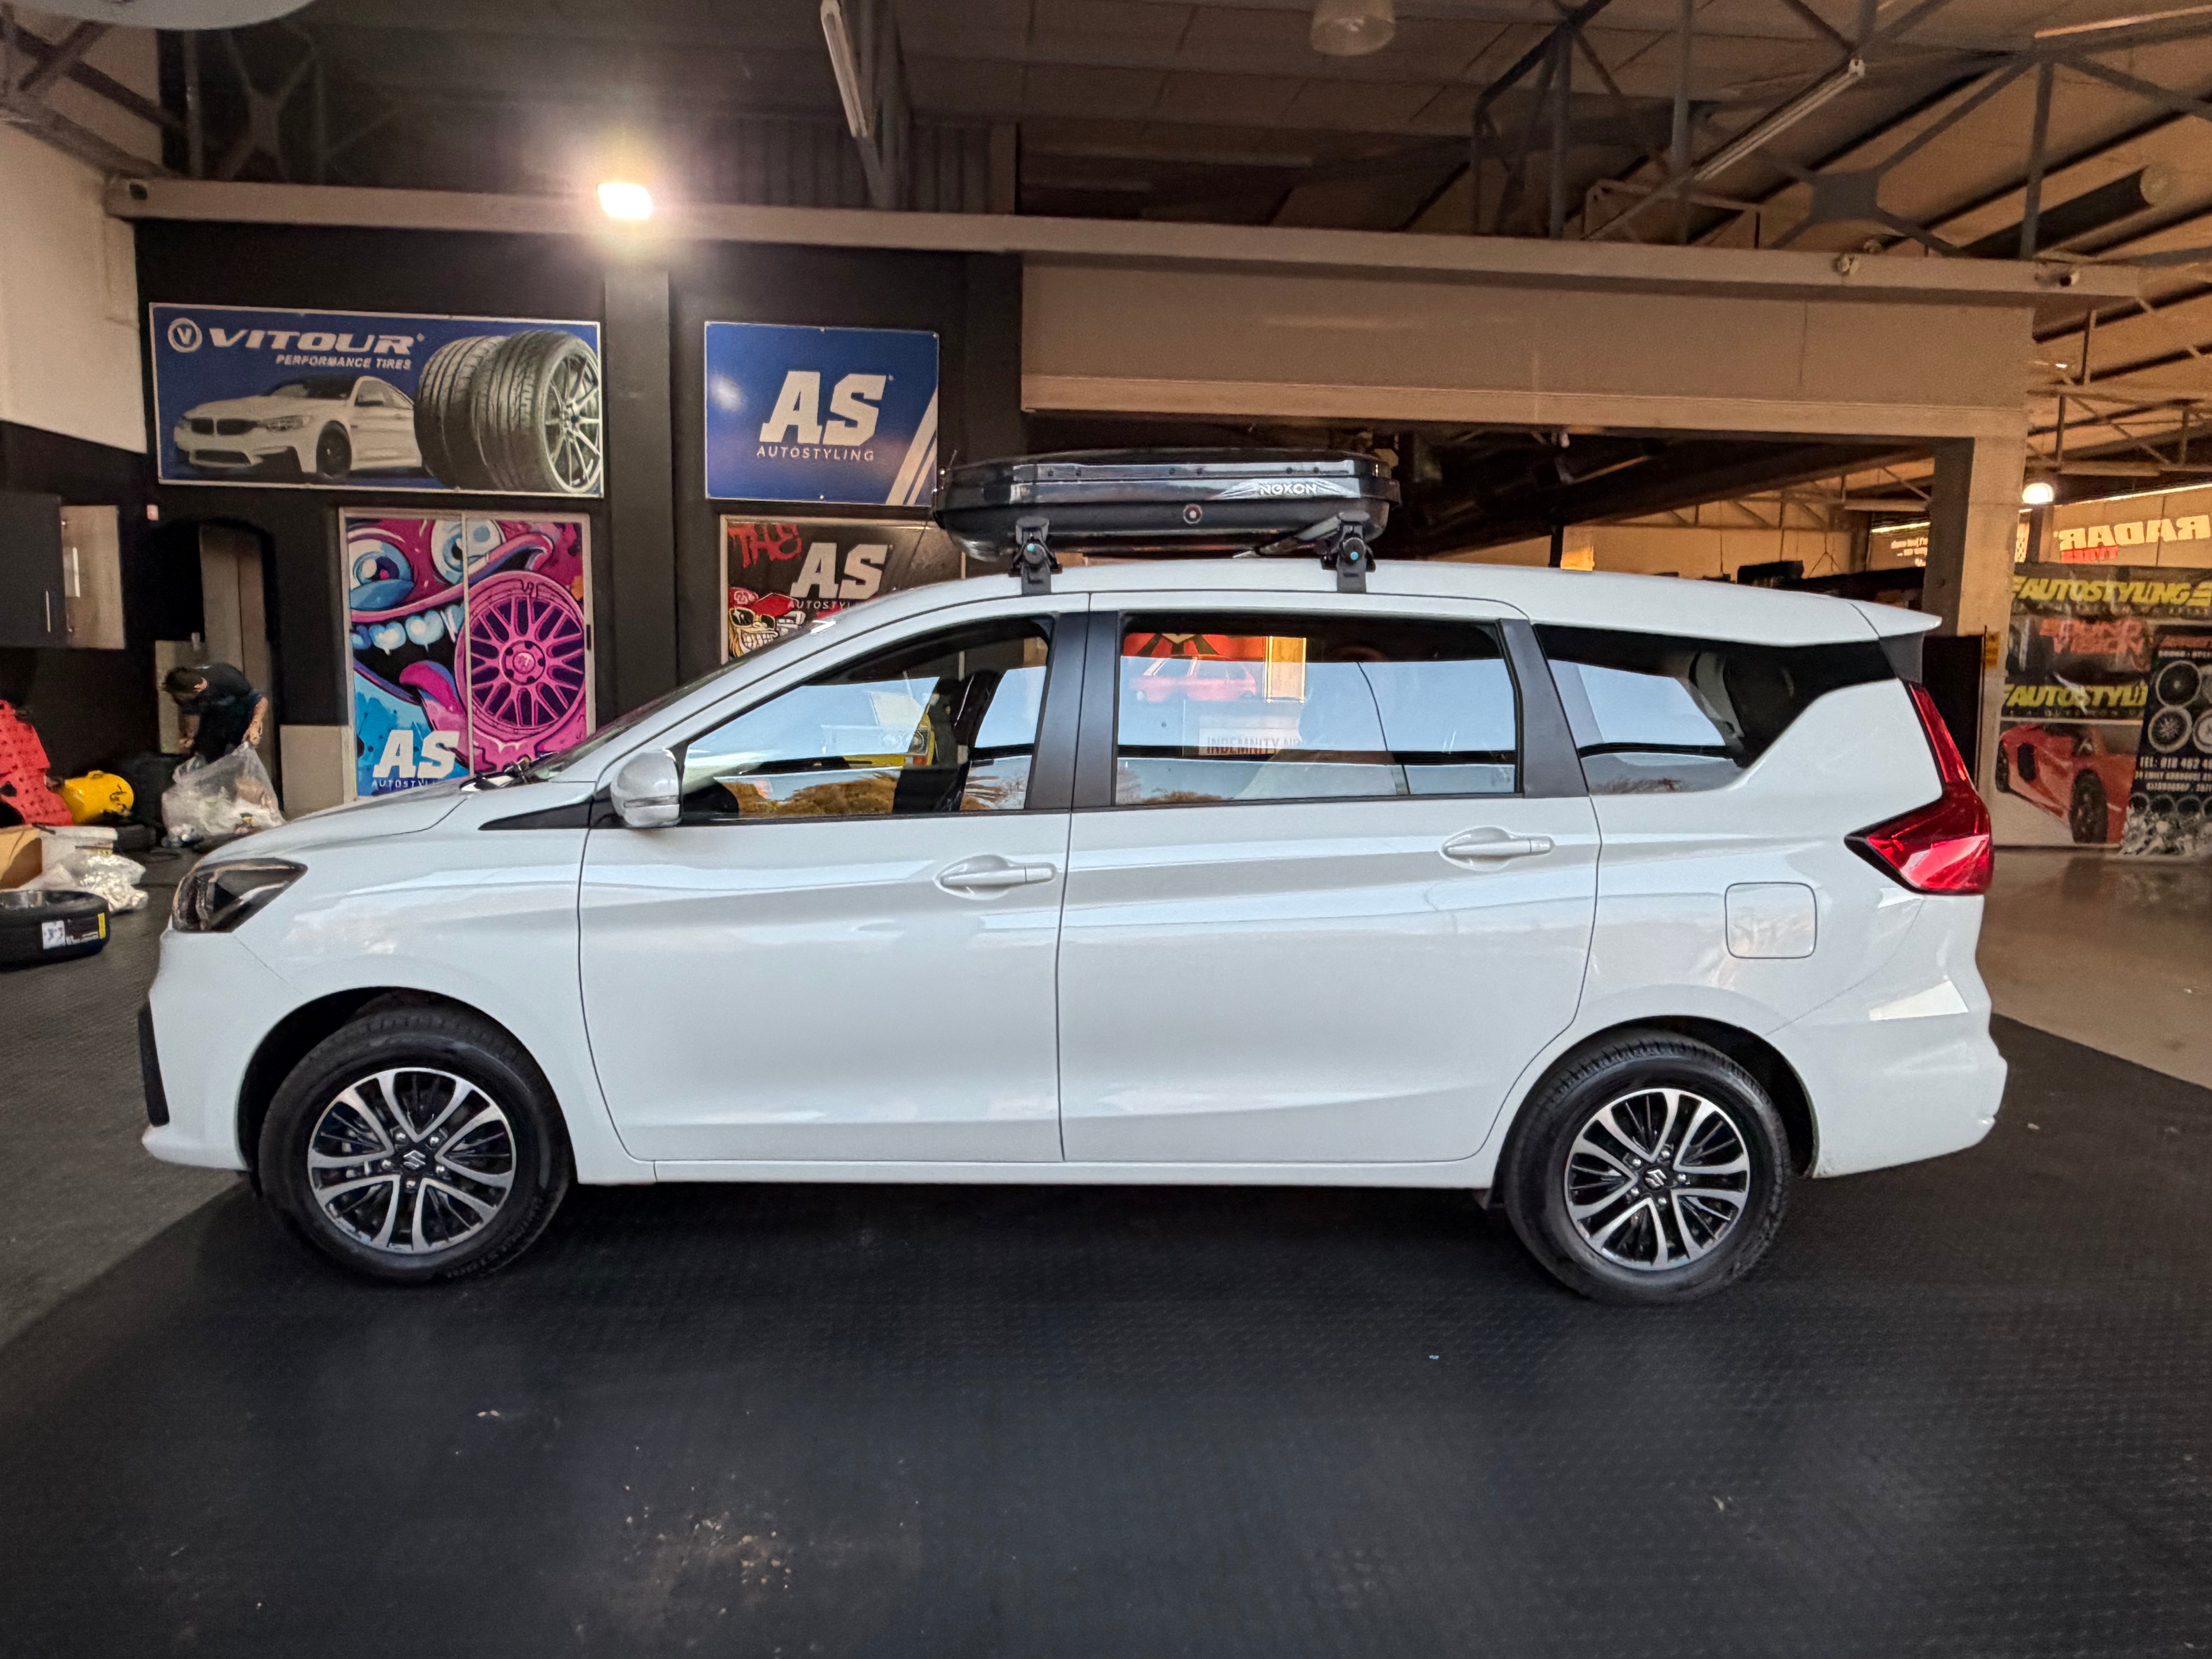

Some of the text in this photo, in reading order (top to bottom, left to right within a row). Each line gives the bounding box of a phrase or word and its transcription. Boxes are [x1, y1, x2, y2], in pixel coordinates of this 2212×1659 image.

[209, 328, 414, 355] VITOUR
[275, 354, 412, 370] PERFORMANCE TIRES
[759, 371, 887, 446] AS
[757, 445, 874, 461] AUTOSTYLING
[790, 542, 888, 599] AS
[2017, 579, 2193, 604] AUTOSTYLING
[787, 600, 853, 610] AUTOSTYL
[373, 730, 460, 778] AS
